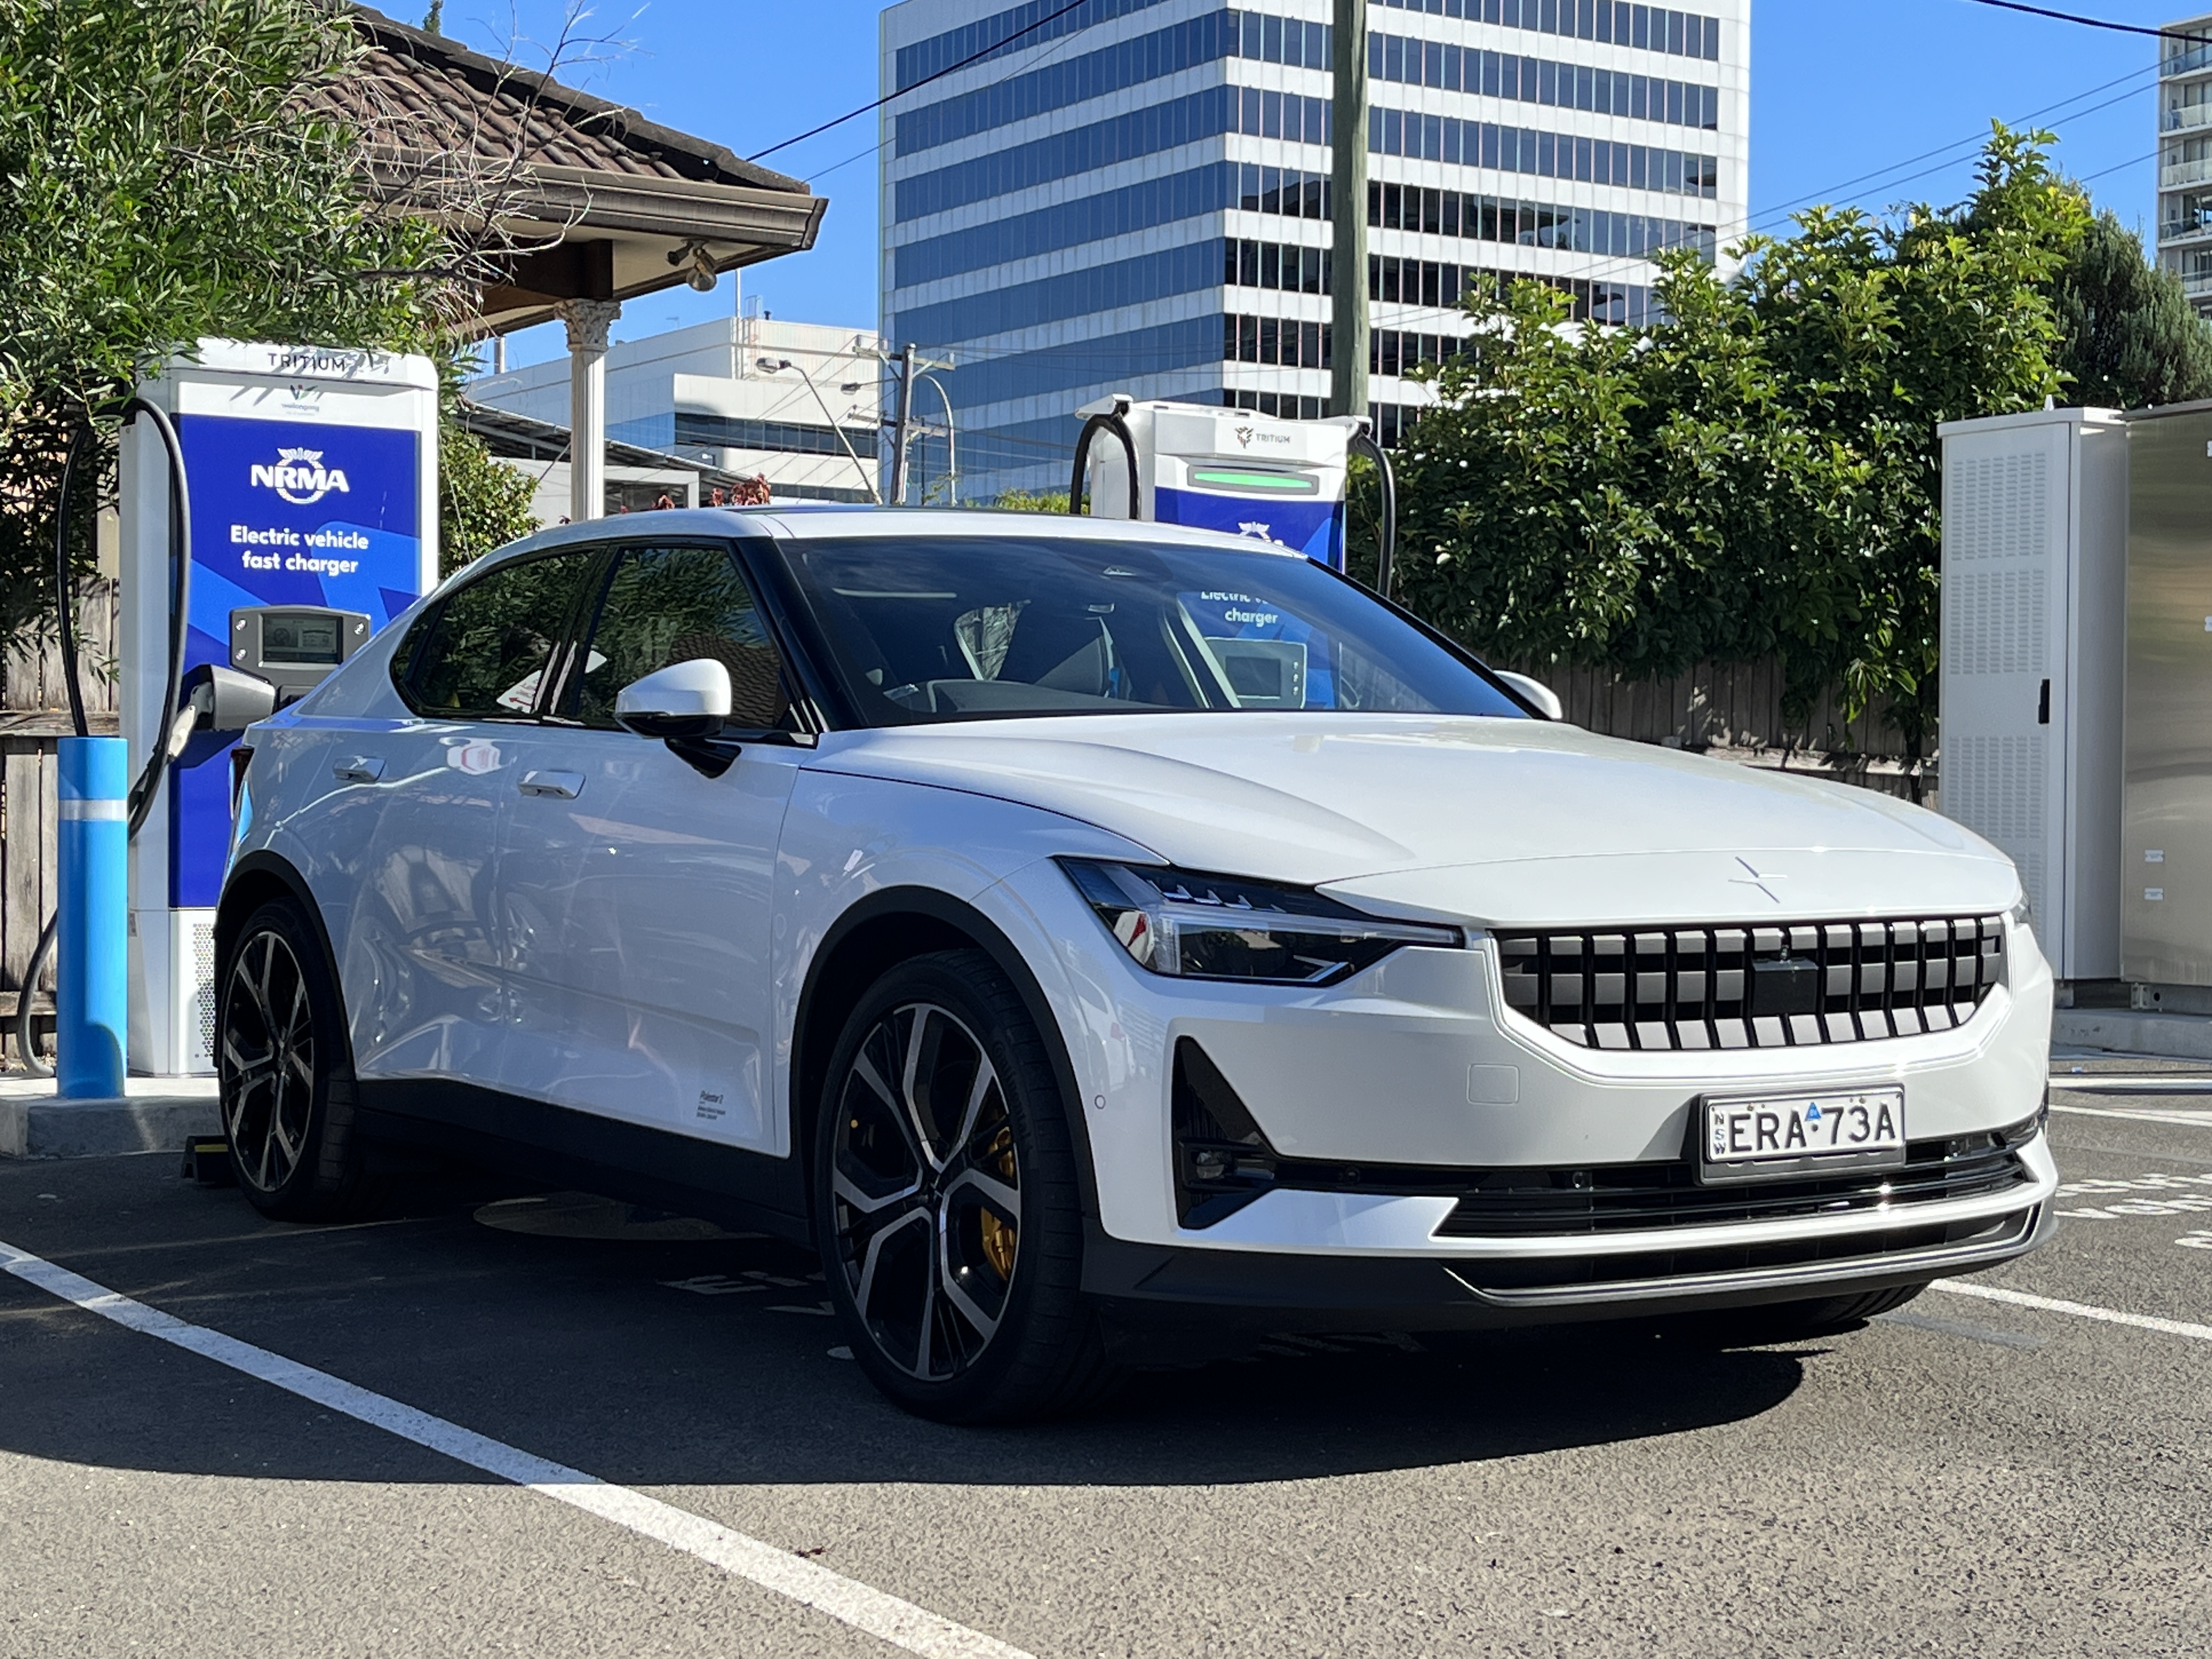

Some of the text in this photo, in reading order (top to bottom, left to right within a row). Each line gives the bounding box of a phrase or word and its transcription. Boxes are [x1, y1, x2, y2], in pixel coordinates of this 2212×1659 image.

[267, 353, 346, 372] TRITIUM
[1256, 433, 1290, 444] TRITIUM
[251, 464, 350, 493] NRMA
[230, 524, 369, 550] Electric vehicle
[241, 550, 359, 577] fast charger
[1224, 607, 1278, 628] charger
